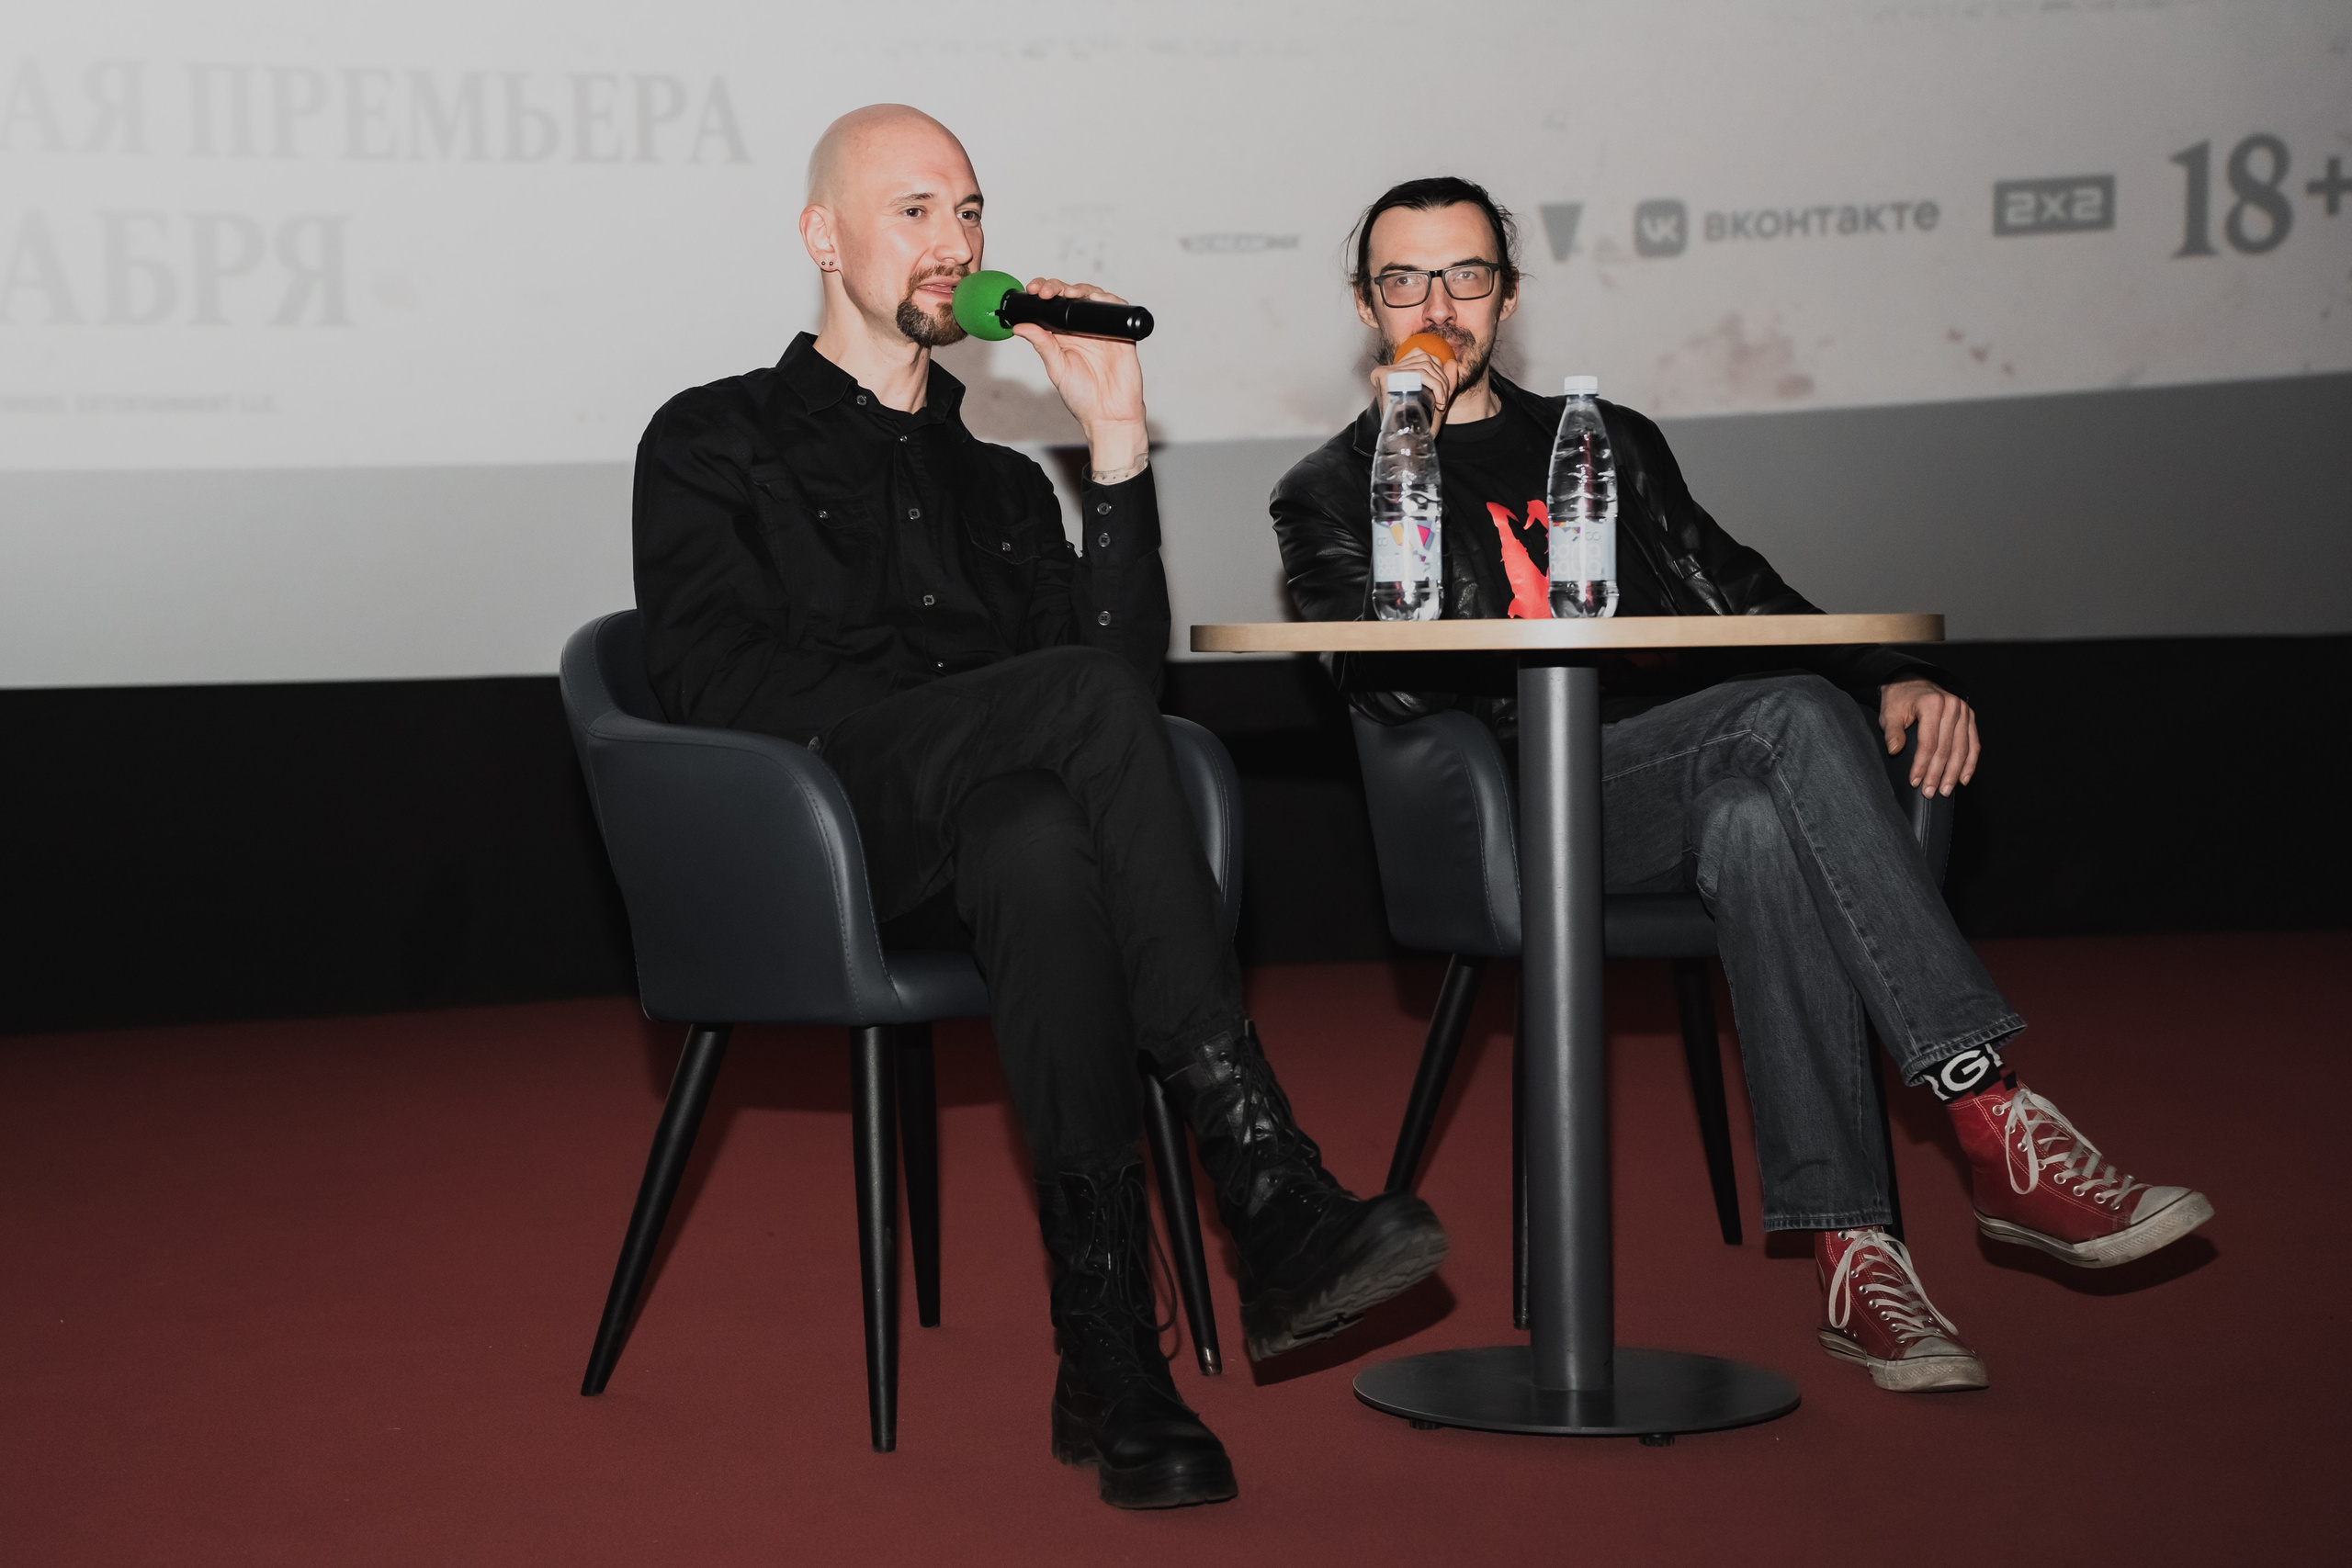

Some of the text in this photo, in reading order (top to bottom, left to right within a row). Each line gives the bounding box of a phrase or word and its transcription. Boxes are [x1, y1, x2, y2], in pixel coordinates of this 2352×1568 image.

[0, 55, 753, 166] АЯ ПРЕМЬЕРА
[2169, 130, 2352, 261] 18+
[0, 208, 356, 329] АБРЯ
